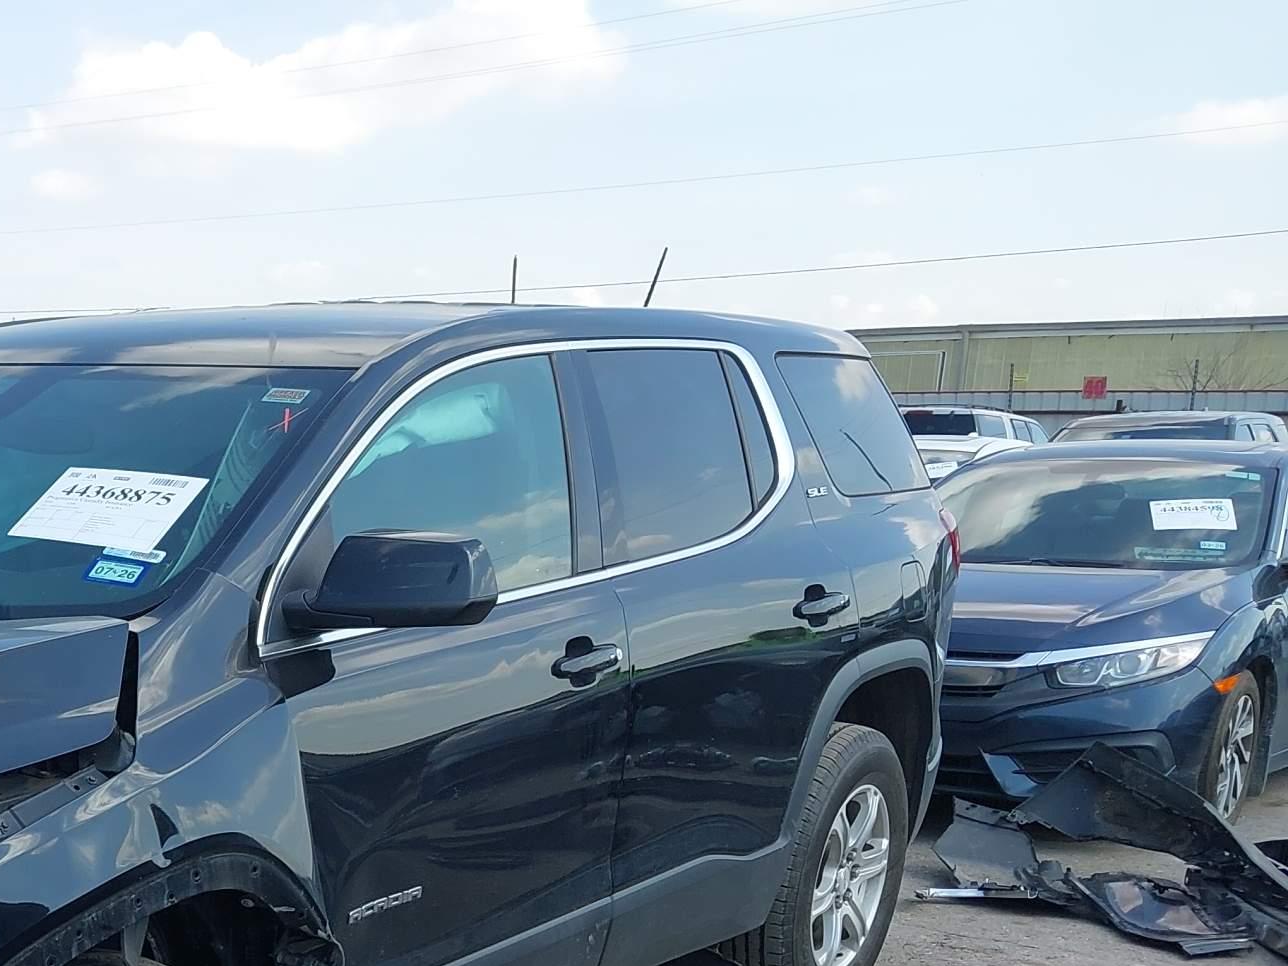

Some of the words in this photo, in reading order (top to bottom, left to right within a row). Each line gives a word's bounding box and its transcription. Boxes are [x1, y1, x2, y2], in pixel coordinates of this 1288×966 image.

[61, 483, 176, 506] 44368875
[807, 486, 828, 498] SLE
[348, 885, 423, 924] ACADIA
